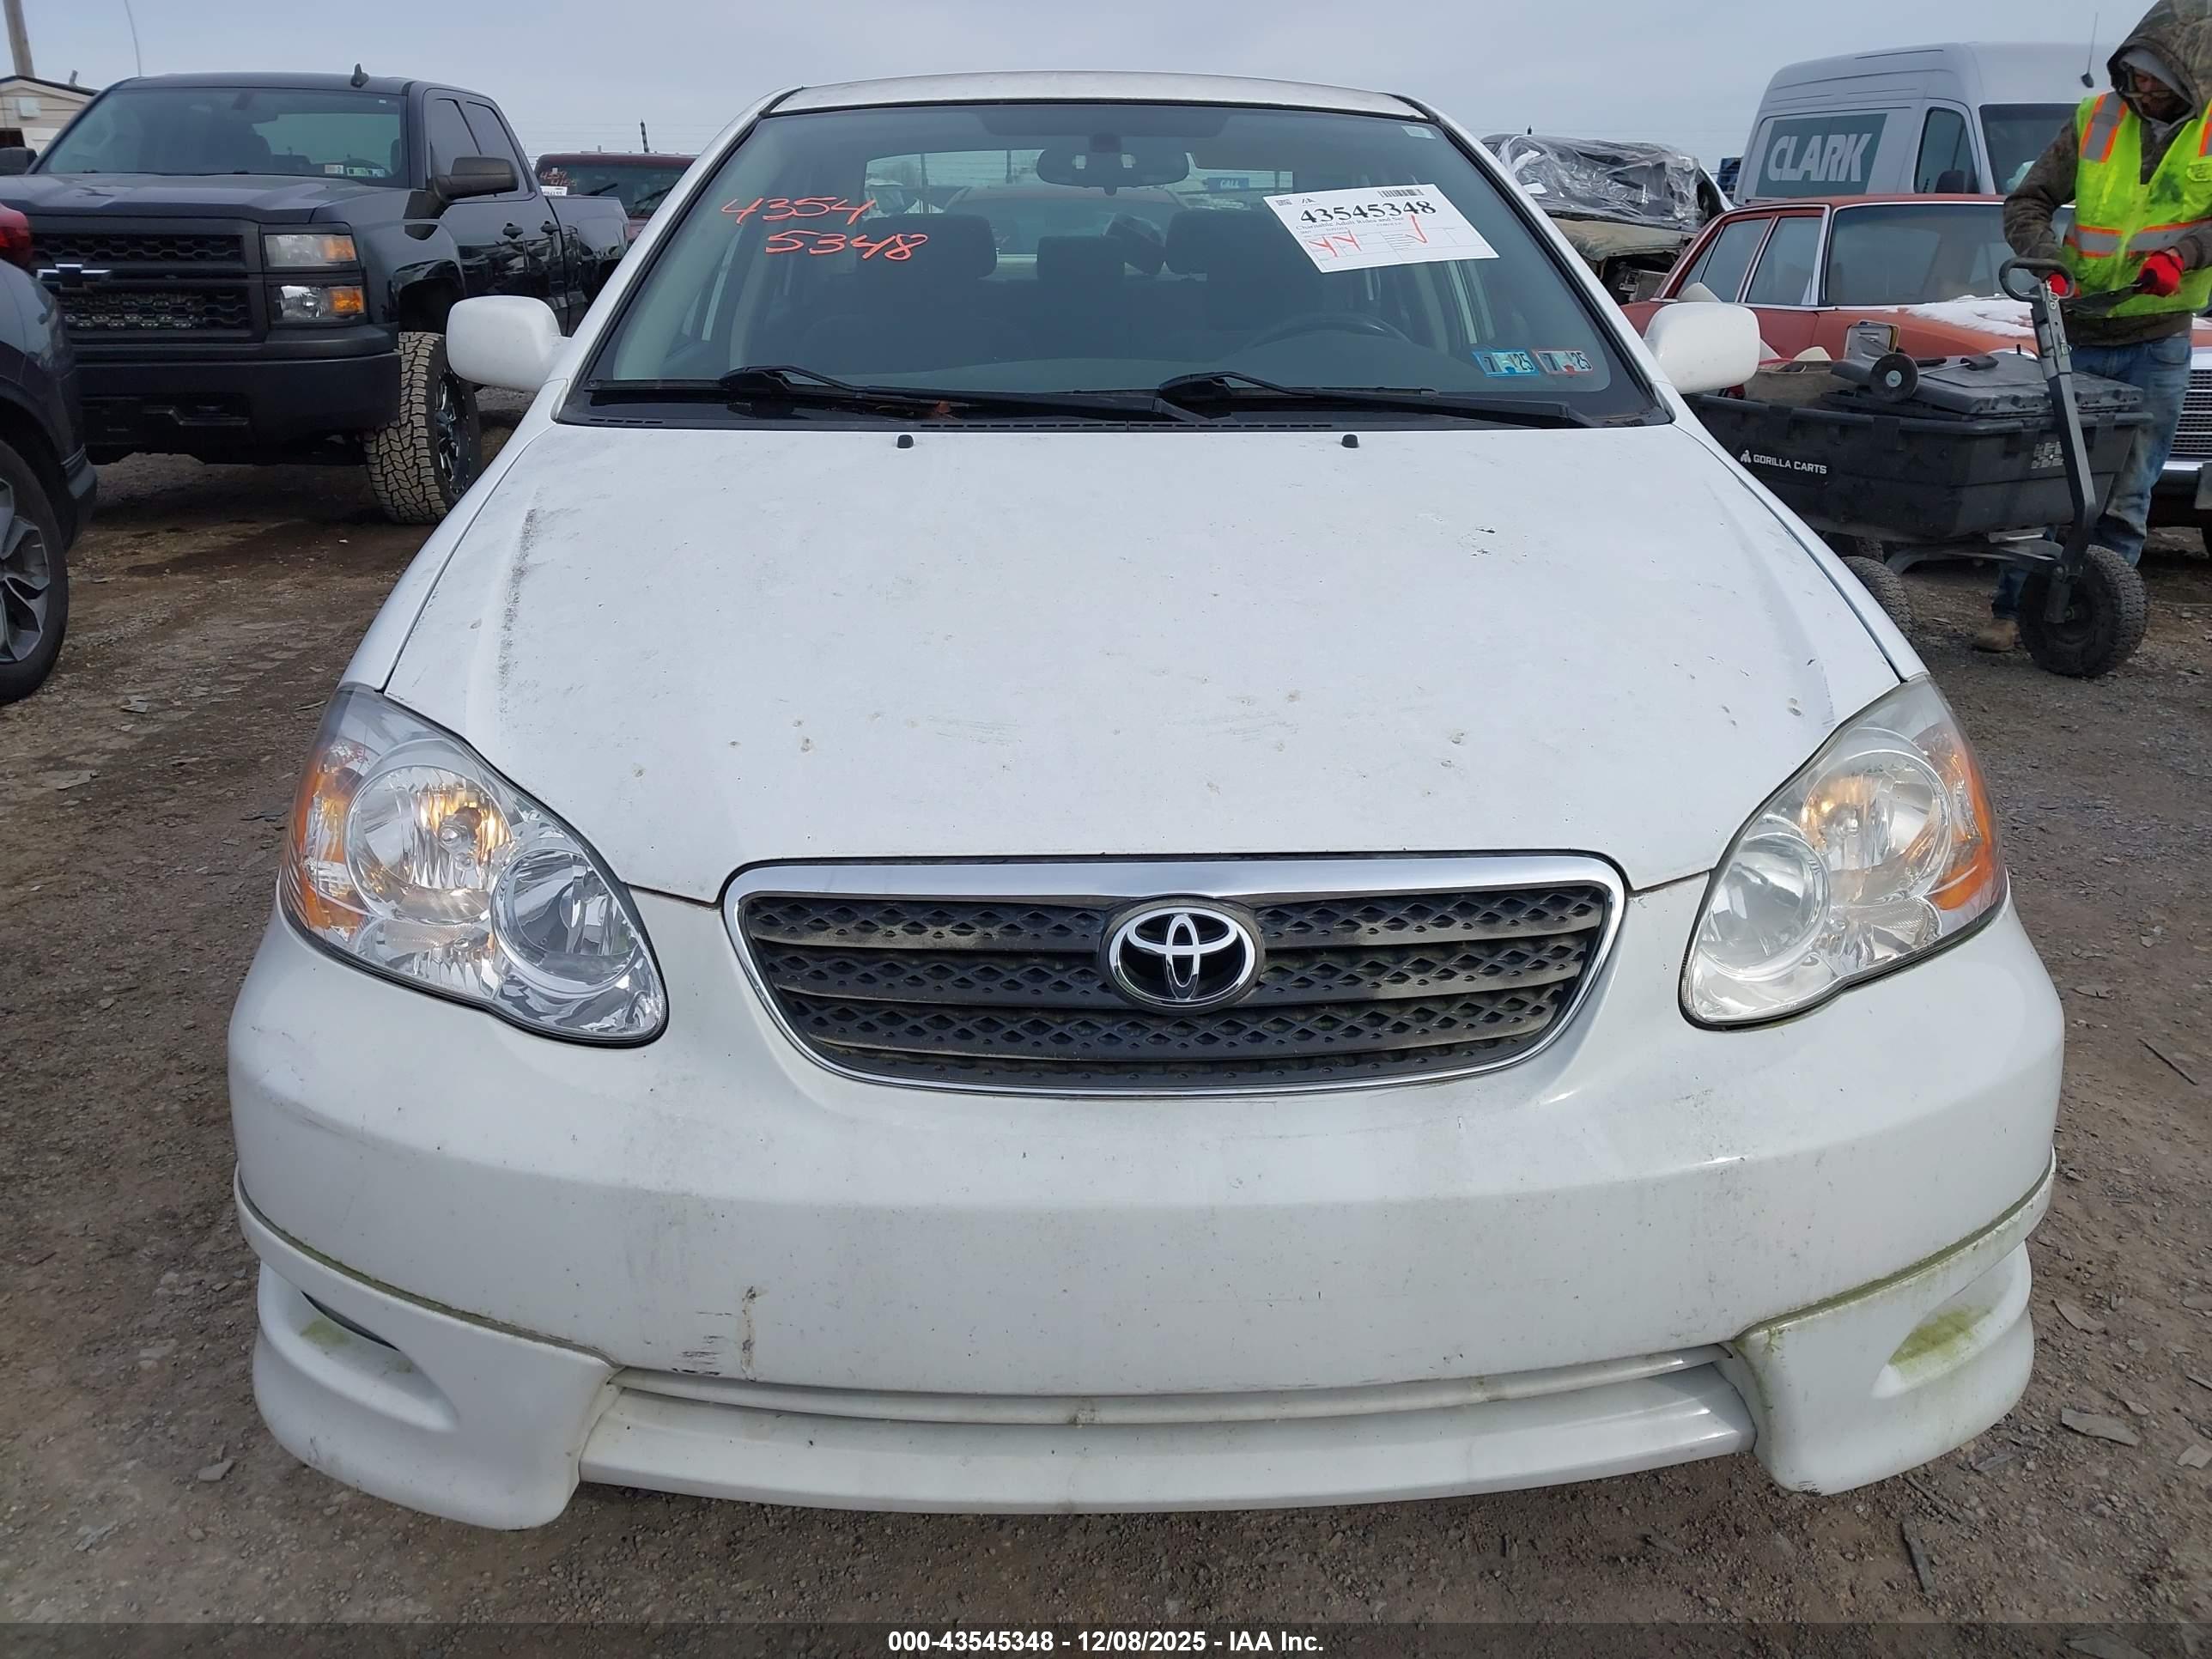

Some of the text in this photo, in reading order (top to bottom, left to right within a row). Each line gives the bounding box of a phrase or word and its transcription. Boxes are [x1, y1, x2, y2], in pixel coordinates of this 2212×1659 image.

[1767, 133, 1873, 182] CLARK
[721, 197, 876, 225] 4354
[1299, 200, 1437, 223] 43545348
[765, 230, 928, 260] 5348
[1514, 353, 1534, 371] 25
[1571, 351, 1591, 369] 25
[1753, 454, 1827, 474] GORILLA CARTS
